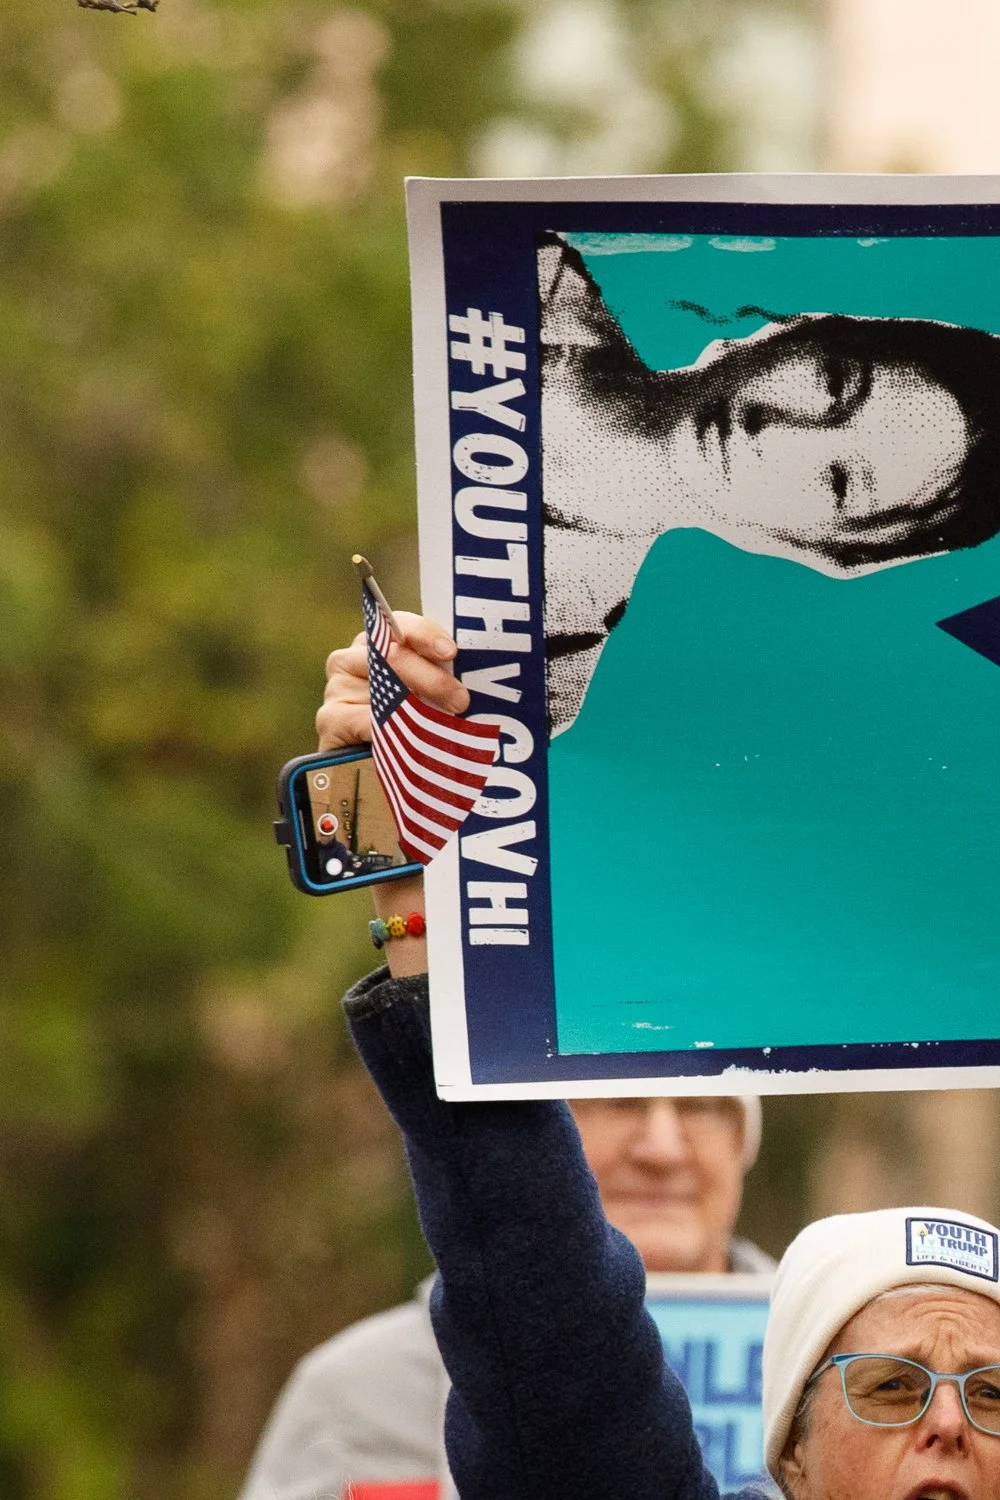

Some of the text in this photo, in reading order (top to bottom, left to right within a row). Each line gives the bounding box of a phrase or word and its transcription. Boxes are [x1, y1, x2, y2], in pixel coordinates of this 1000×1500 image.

[923, 1222, 988, 1248] YOUTH
[937, 1236, 989, 1258] TRUMP
[950, 1257, 990, 1275] LIBERTY
